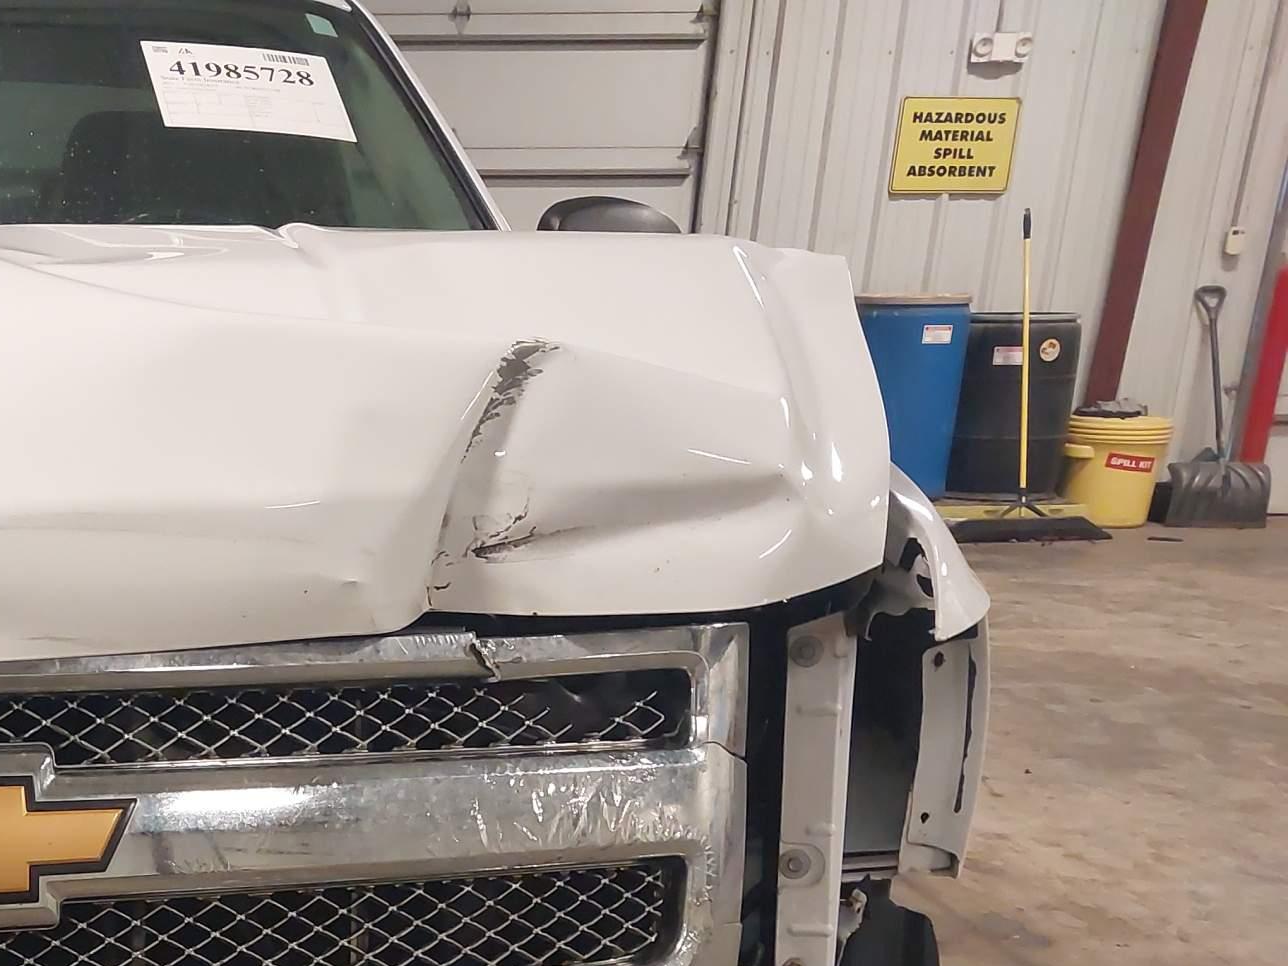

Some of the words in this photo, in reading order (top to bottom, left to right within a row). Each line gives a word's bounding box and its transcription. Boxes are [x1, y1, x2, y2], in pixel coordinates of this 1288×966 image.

[169, 60, 314, 87] 41985728
[912, 111, 1007, 125] HAZARDOUS
[919, 129, 994, 142] MATERIAL
[933, 147, 974, 160] SPILL
[906, 165, 996, 178] ABSORBENT
[1110, 456, 1136, 468] SPILL
[1138, 460, 1152, 470] KIT
